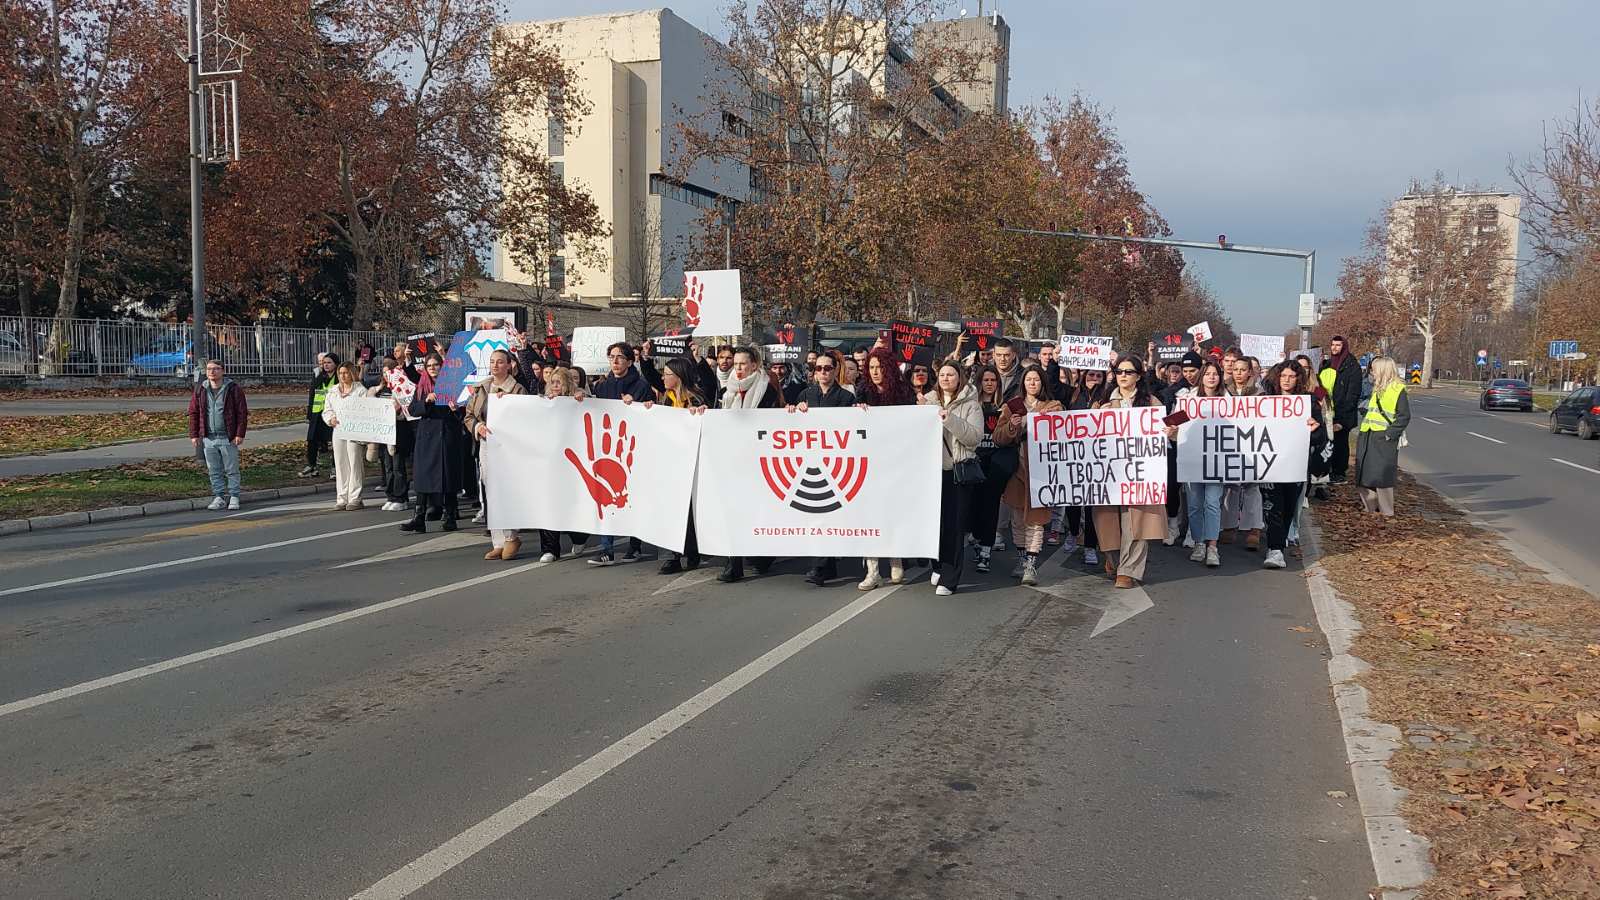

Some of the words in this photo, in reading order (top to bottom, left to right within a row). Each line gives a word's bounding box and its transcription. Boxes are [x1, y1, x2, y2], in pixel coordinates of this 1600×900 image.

[892, 323, 920, 334] HULJA
[921, 327, 933, 337] SE
[896, 333, 926, 345] LJULJA
[653, 338, 686, 348] ZASTANI
[656, 346, 684, 354] SRBIJO
[1062, 336, 1085, 344] ОВАЈ
[1087, 337, 1113, 346] ИСПИТ
[1069, 345, 1099, 355] НЕМА
[1179, 396, 1304, 419] ПОСТОЈАНСТВО
[1034, 411, 1130, 441] ПРОБУДИ
[1140, 408, 1160, 435] СЕ
[772, 430, 851, 450] SPFLV
[1202, 425, 1274, 453] НЕМА
[1039, 441, 1085, 463] НЕШТО
[1092, 438, 1108, 462] СЕ
[1109, 436, 1167, 463] ДЕШАВА
[1048, 464, 1058, 485] И
[1066, 461, 1116, 484] ТВОЈА
[1125, 461, 1145, 482] СЕ
[1202, 453, 1278, 482] ЦЕНУ
[1038, 483, 1112, 507] СУДБИНА
[1120, 482, 1167, 506] РЕШАВА
[753, 527, 806, 536] STUDENTI
[809, 527, 823, 536] ZA
[826, 527, 881, 537] STUDENTE
